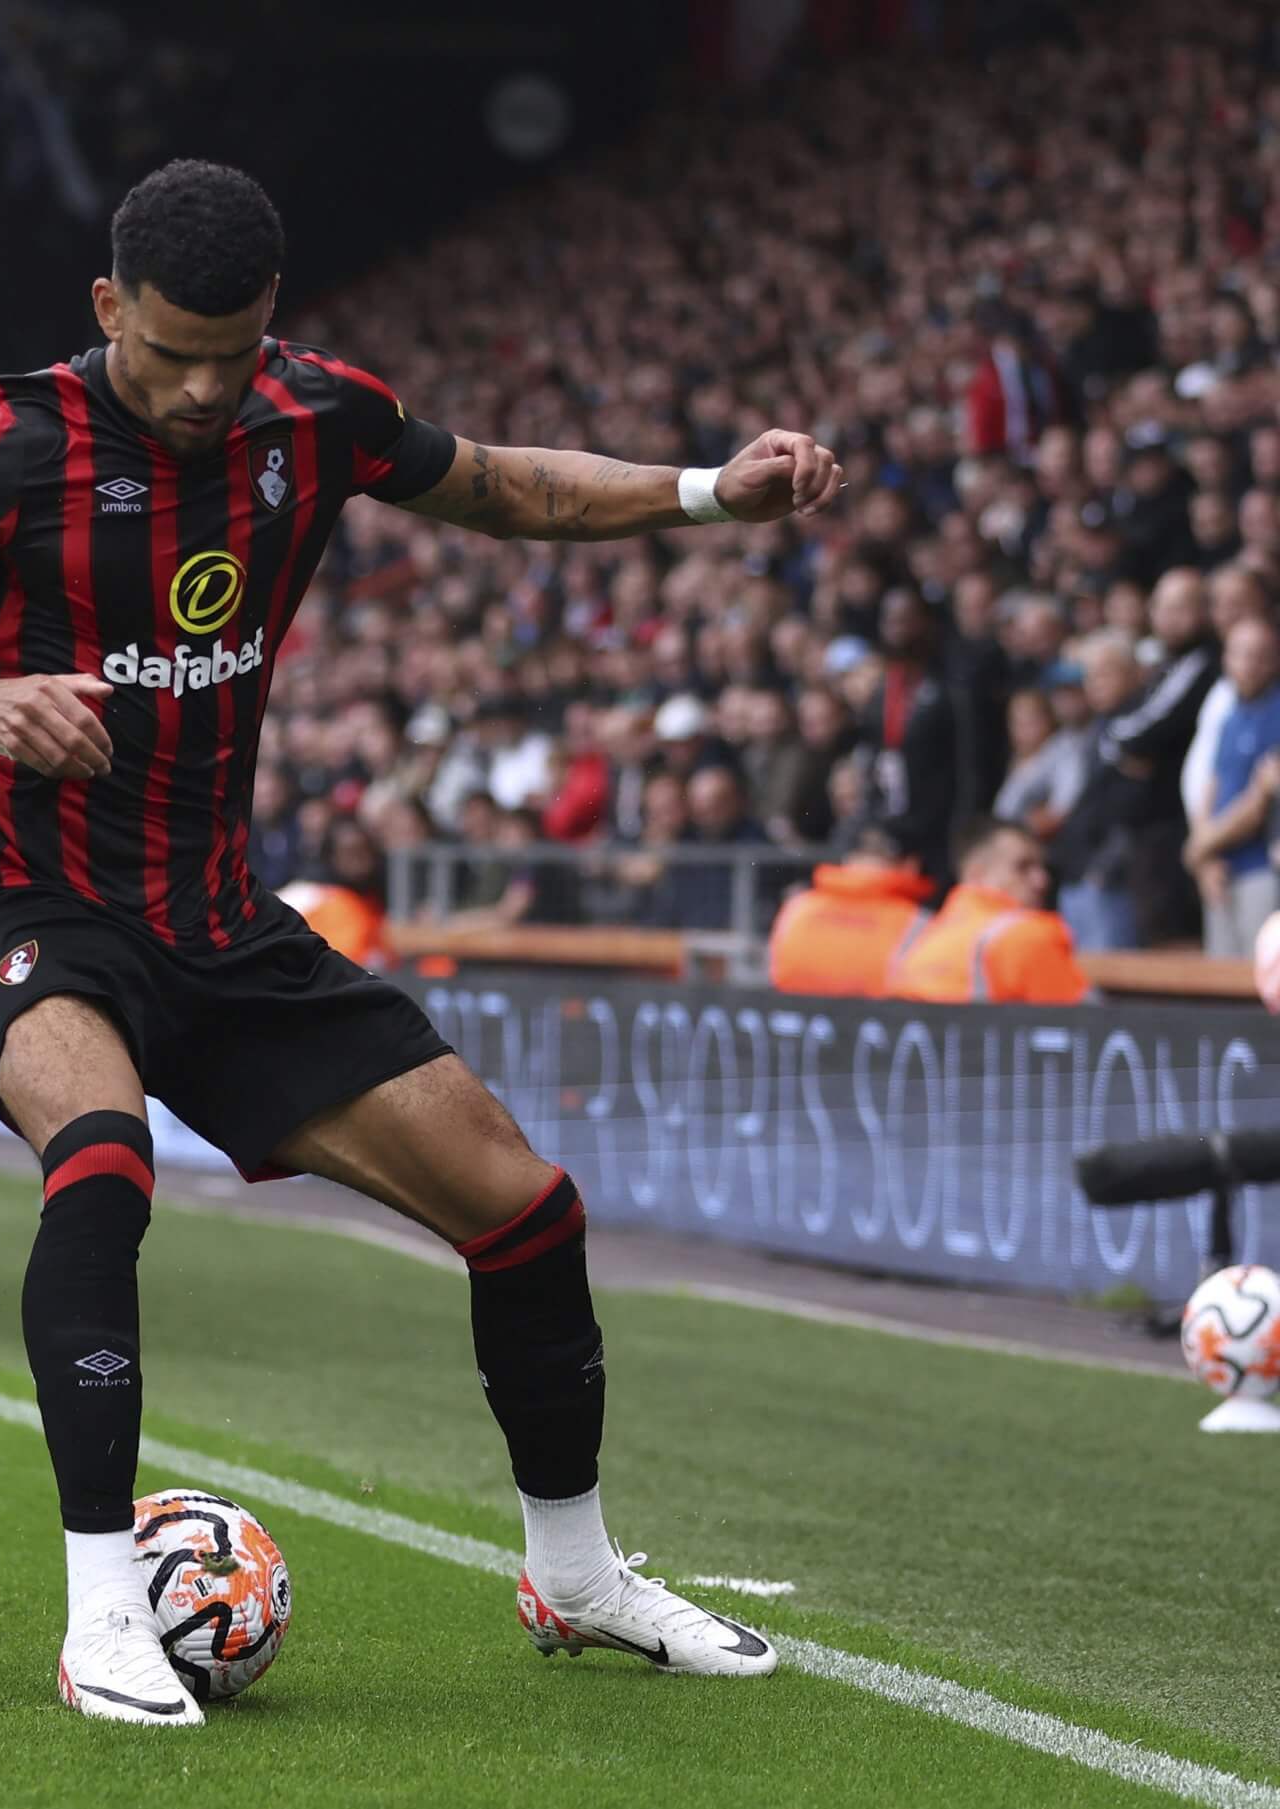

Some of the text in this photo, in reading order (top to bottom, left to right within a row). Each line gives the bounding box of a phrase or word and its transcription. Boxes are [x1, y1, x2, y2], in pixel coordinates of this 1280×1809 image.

[101, 500, 142, 513] umbro
[102, 625, 265, 699] dafabet
[628, 1001, 838, 1236] SPORTS
[78, 1376, 131, 1387] umbro
